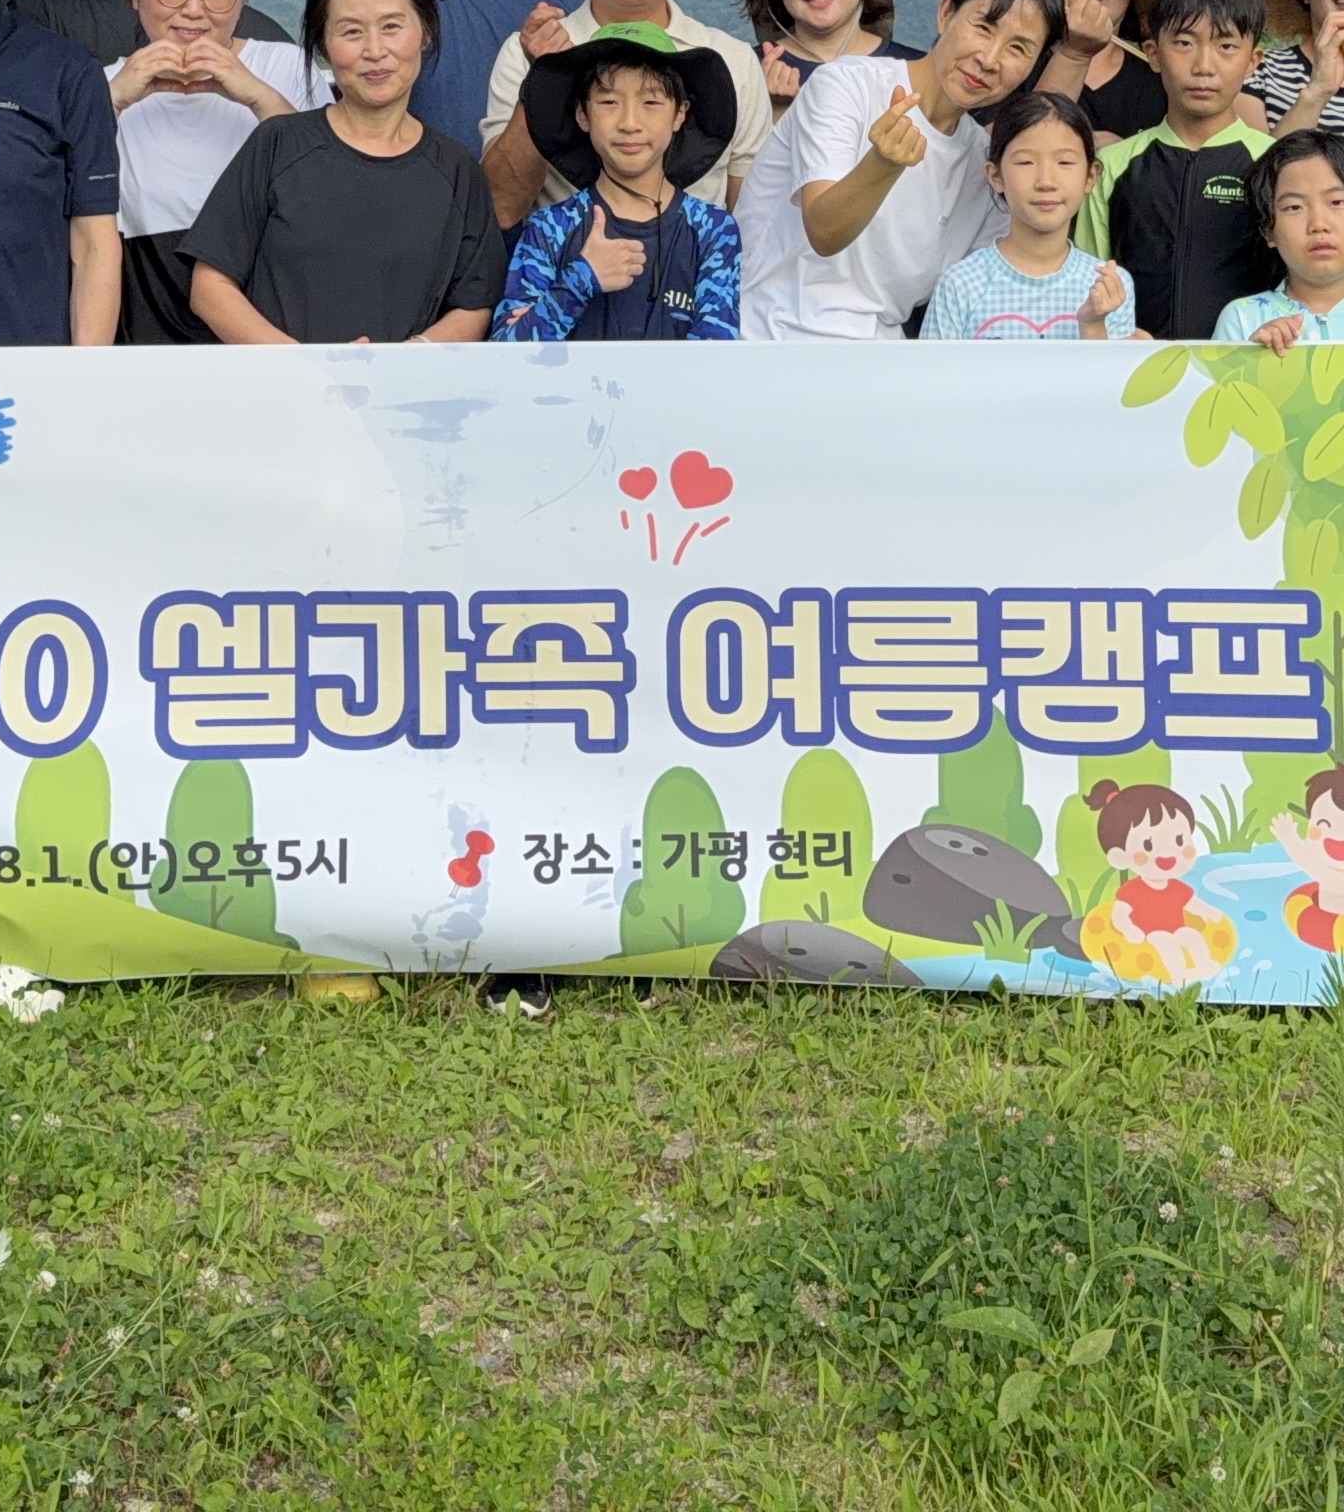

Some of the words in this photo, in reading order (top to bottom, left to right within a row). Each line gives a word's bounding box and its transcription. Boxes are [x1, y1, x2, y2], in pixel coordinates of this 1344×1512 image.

[1202, 184, 1245, 197] Atlant
[139, 589, 637, 760] 셀가족
[666, 587, 1332, 756] 여름캠프
[522, 832, 615, 885] 장소
[661, 830, 749, 882] 가평
[766, 827, 854, 881] 현리
